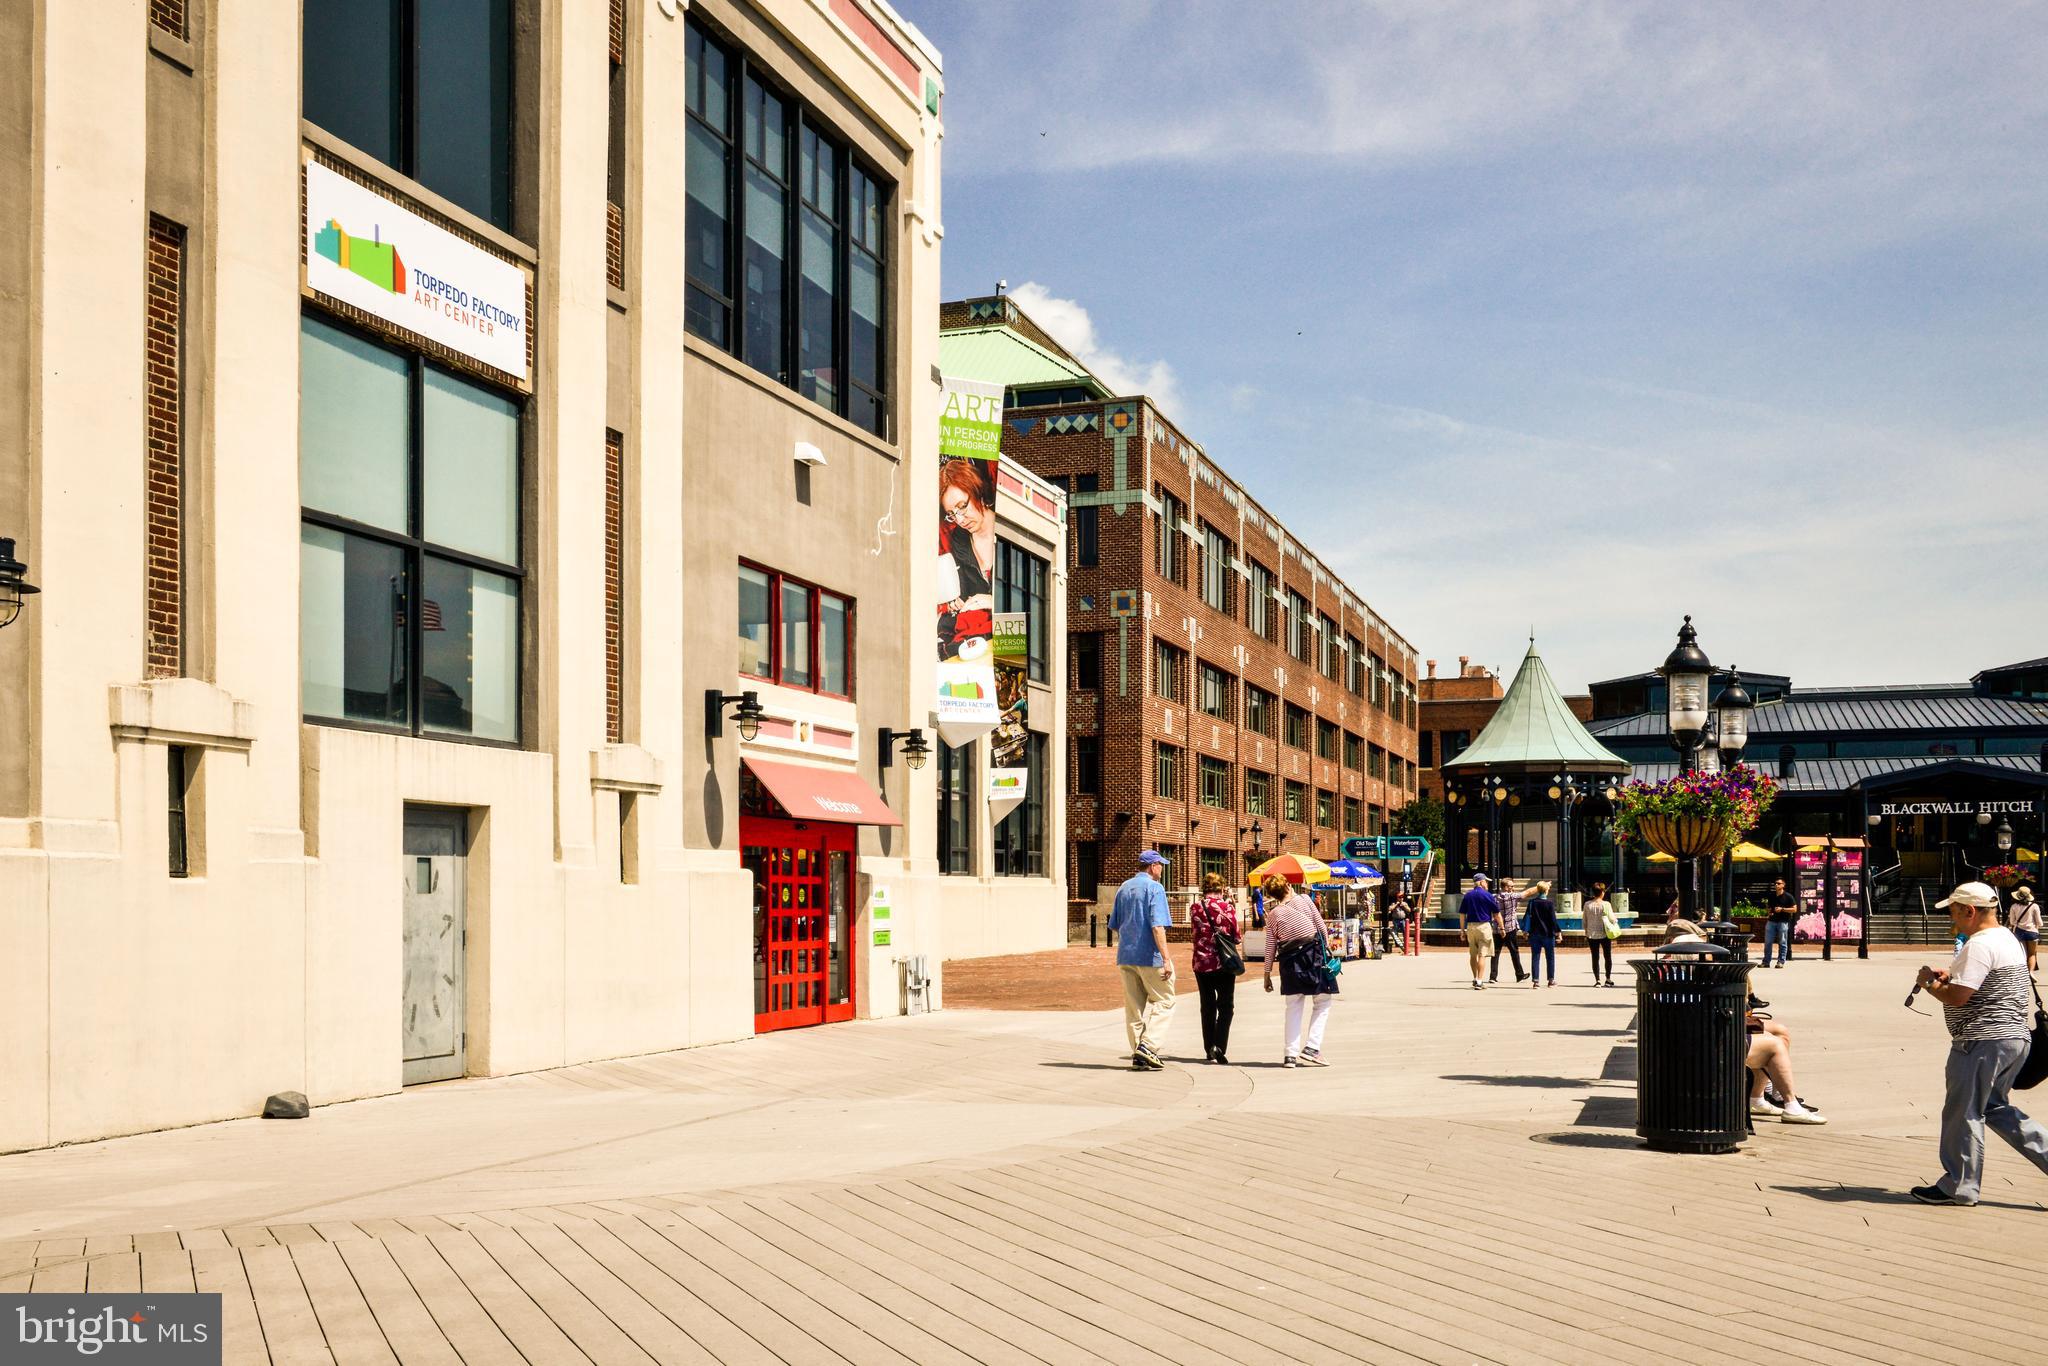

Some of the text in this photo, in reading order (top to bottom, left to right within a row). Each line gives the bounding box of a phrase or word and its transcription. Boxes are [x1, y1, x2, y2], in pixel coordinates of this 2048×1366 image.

[414, 268, 520, 332] TORPEDO FACTORY
[414, 289, 494, 336] ART CENTER
[943, 392, 1000, 422] ART
[940, 425, 998, 443] IN PERSON
[947, 438, 954, 447] IN
[957, 440, 997, 452] PROGRESS
[994, 621, 1024, 635] ART
[812, 795, 862, 814] Welcome
[1881, 801, 2033, 815] BLACKWALL HITCH
